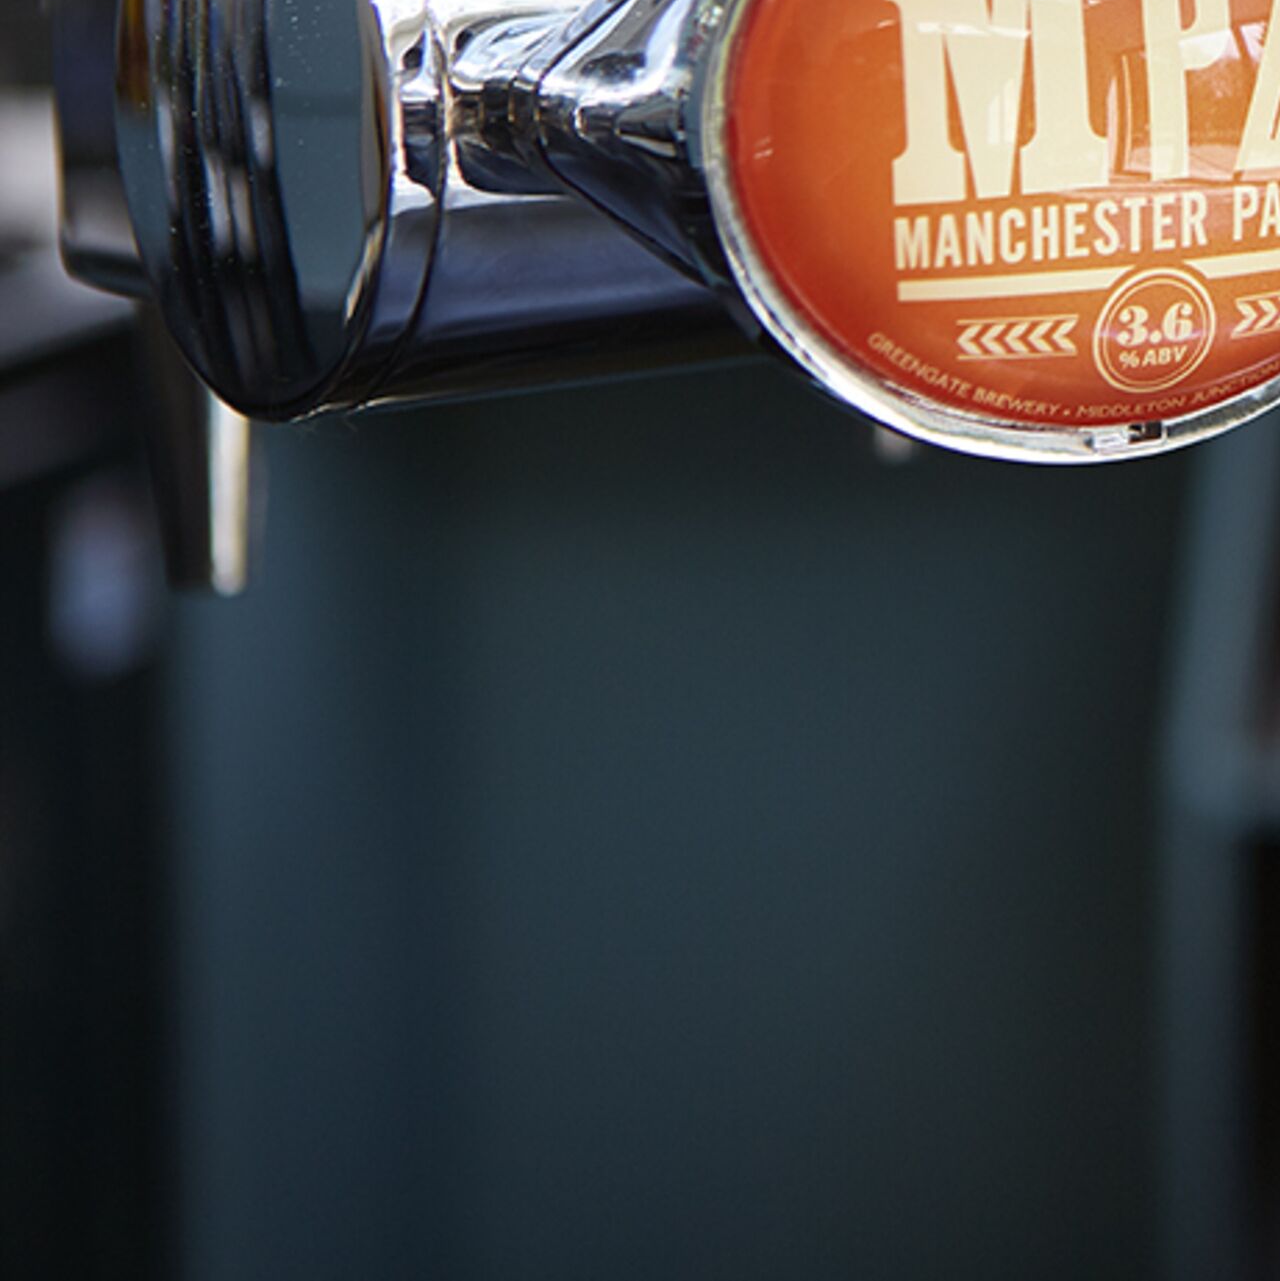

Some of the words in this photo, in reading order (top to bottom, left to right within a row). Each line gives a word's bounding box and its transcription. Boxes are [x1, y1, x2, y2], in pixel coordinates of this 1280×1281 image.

[893, 189, 1209, 270] MANCHESTER
[1115, 301, 1193, 348] 3.6
[867, 331, 972, 396] GREENGATE
[972, 385, 1059, 417] BREWERY
[1075, 396, 1188, 419] MIDDLETON
